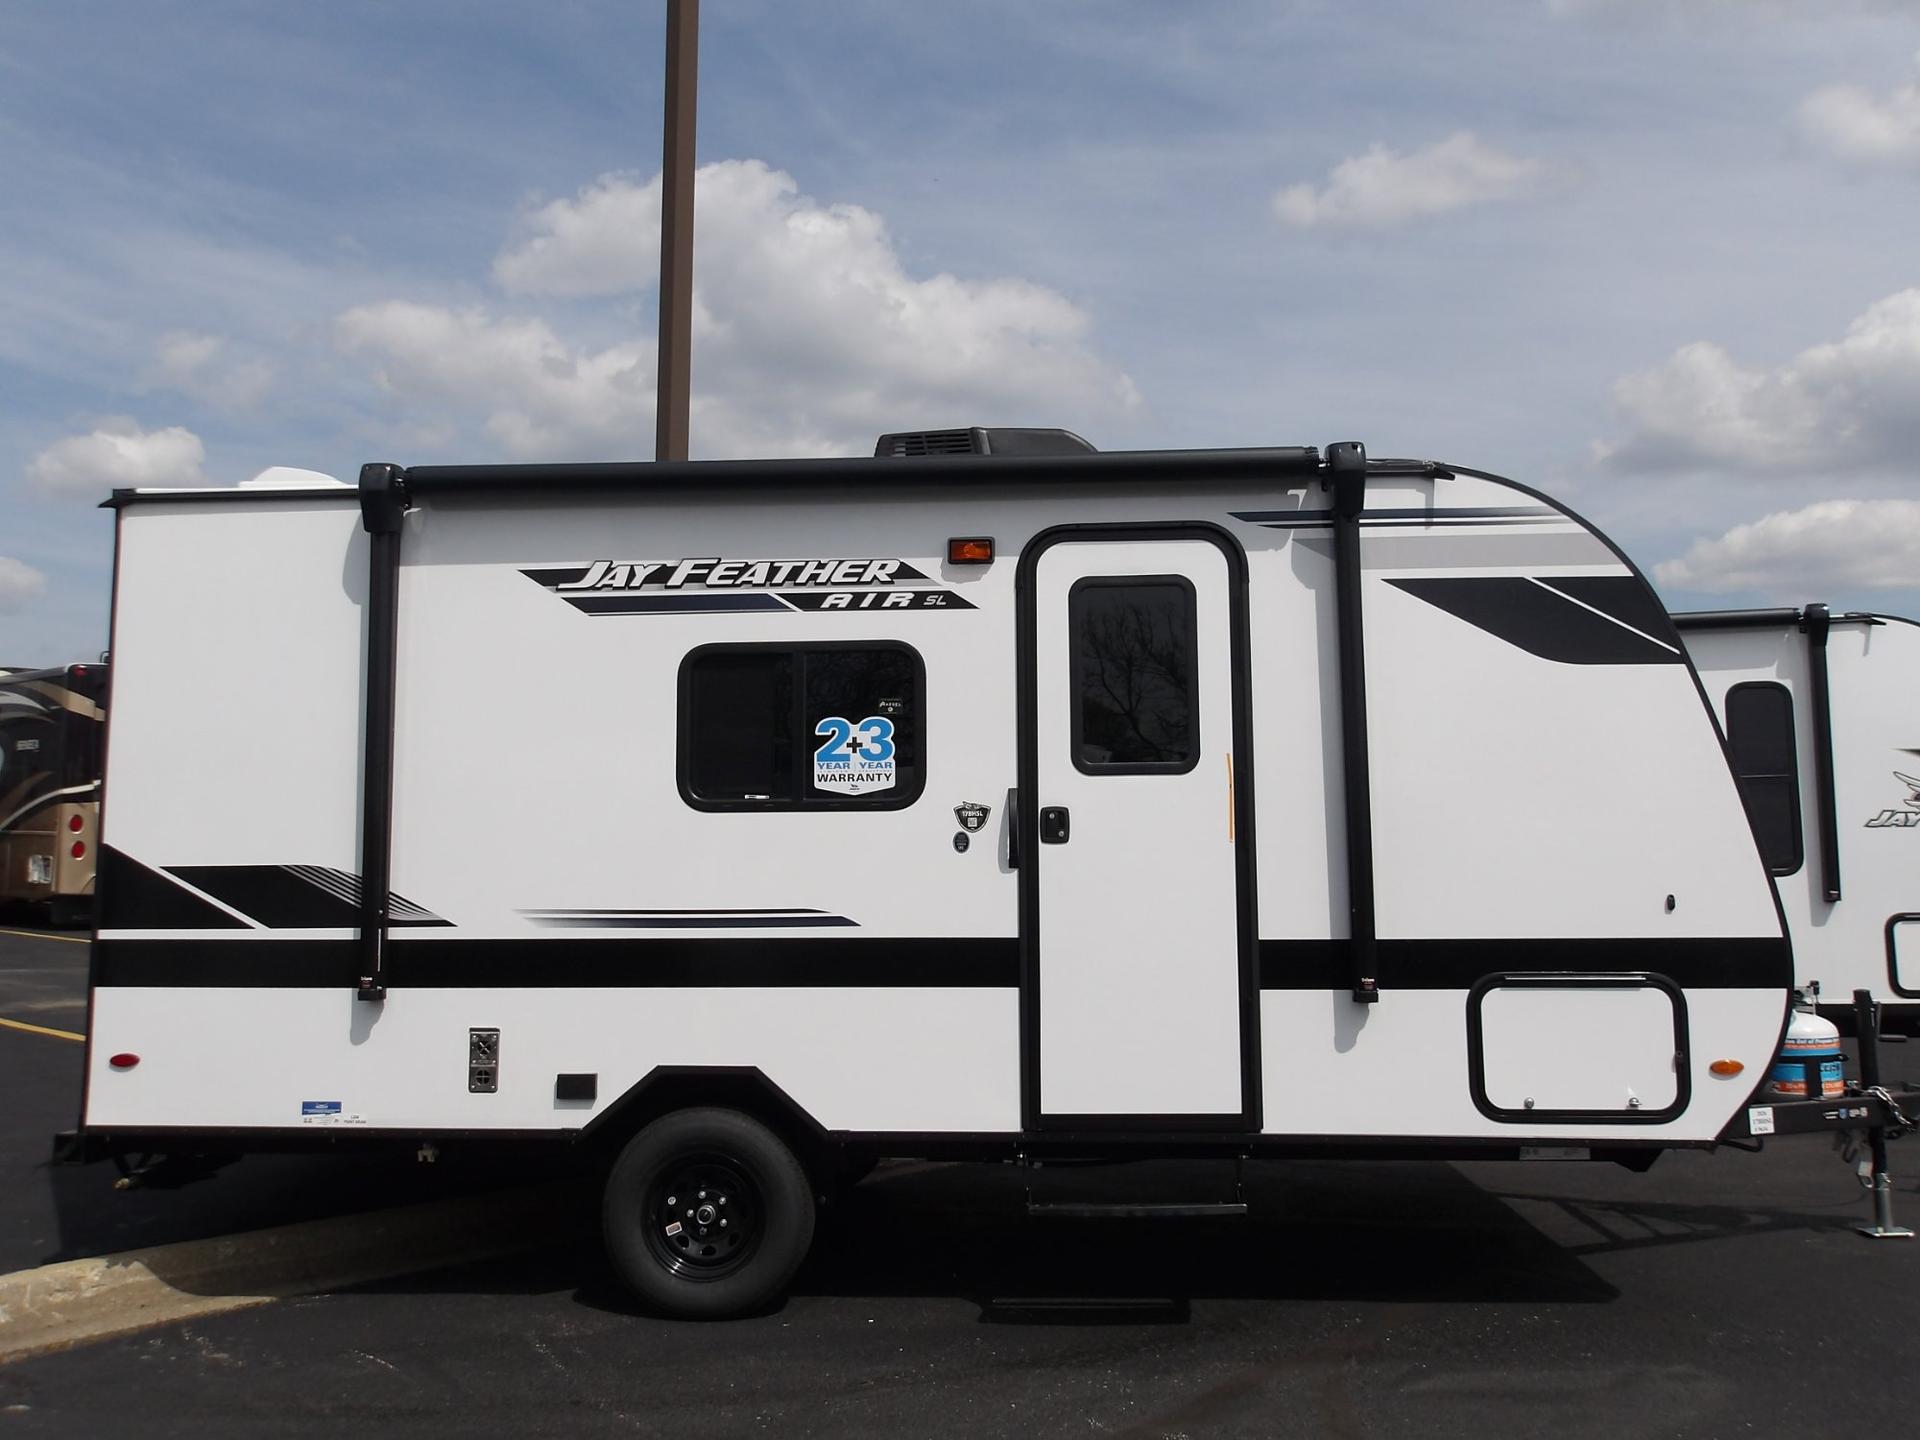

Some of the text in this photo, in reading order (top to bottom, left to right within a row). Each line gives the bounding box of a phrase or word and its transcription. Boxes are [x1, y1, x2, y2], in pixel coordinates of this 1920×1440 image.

[557, 558, 901, 590] JAY FEATHER
[820, 593, 947, 608] AIR SL
[817, 762, 850, 770] YEAR
[817, 773, 893, 782] WARRANTY
